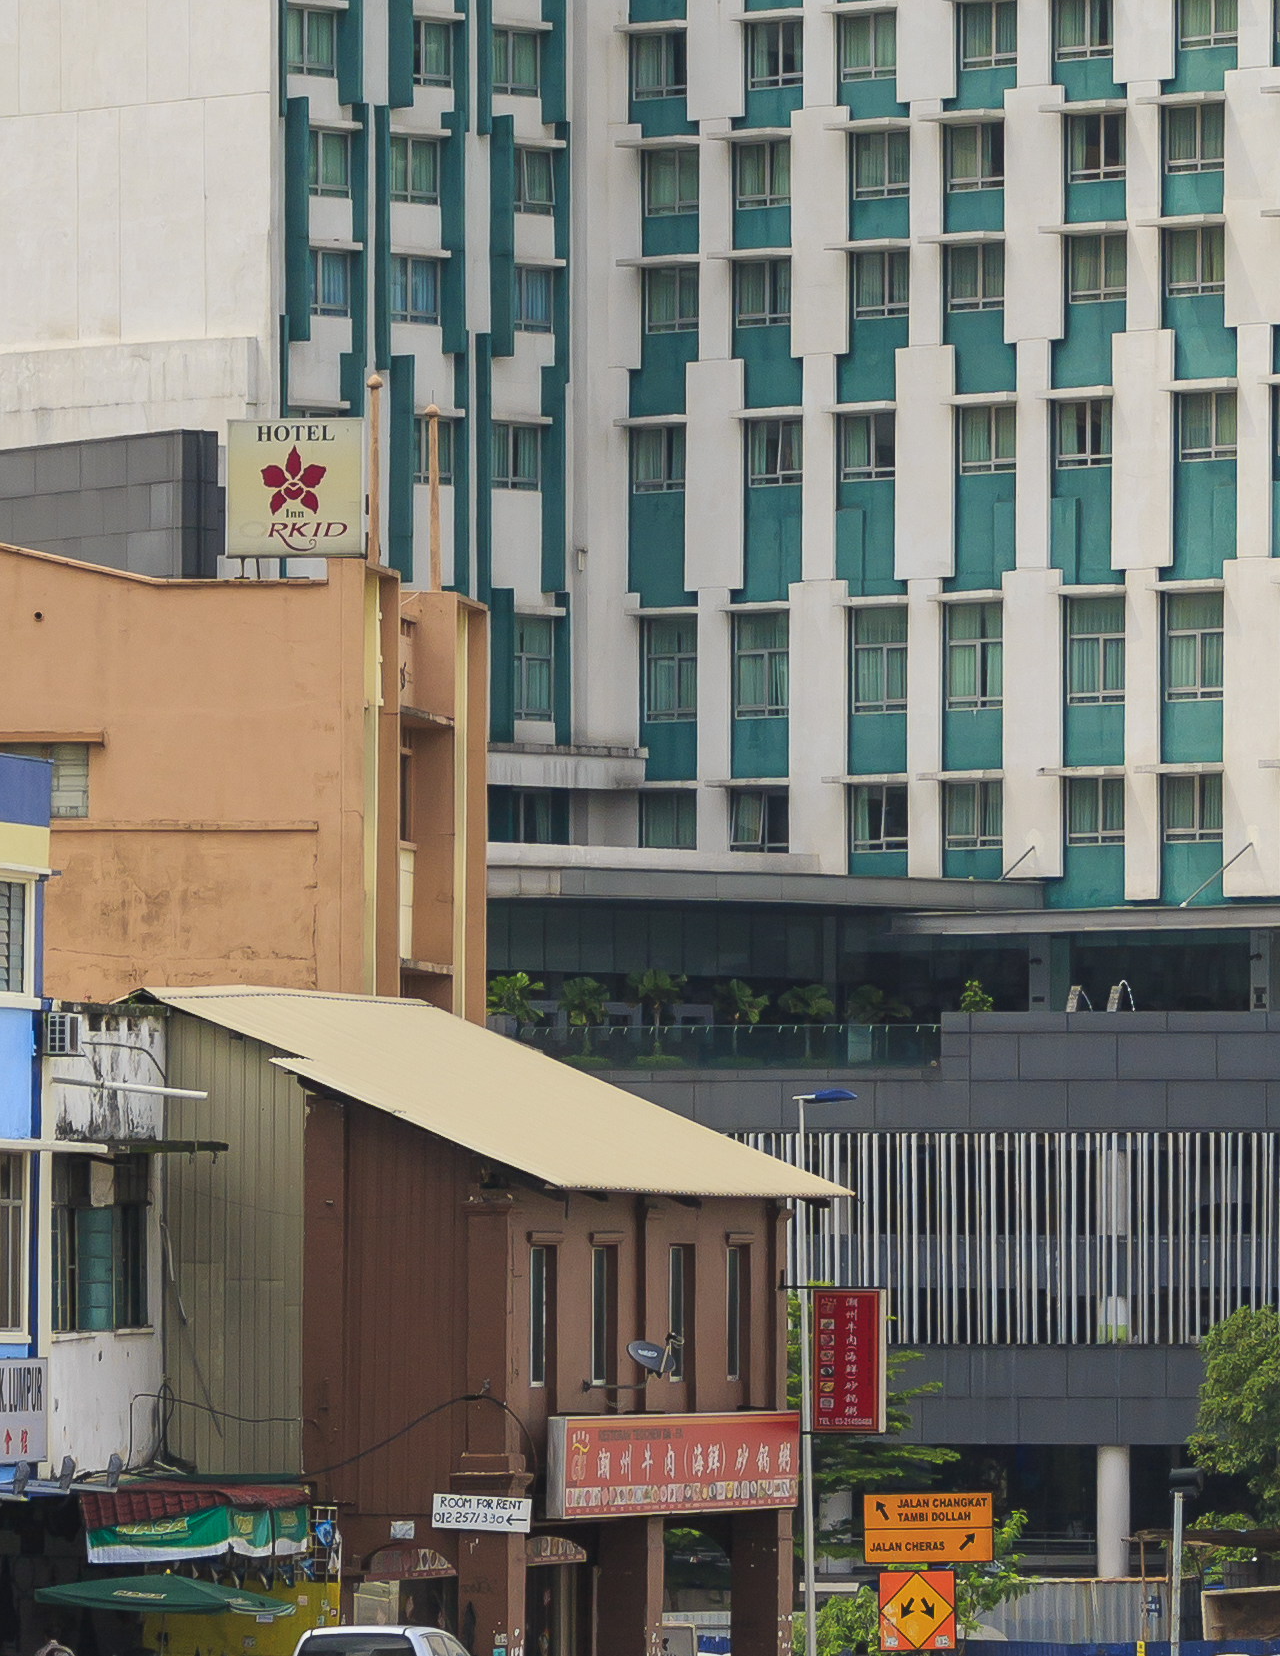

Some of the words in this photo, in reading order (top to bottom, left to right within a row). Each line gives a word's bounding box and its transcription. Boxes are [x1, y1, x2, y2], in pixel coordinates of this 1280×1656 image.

[257, 424, 335, 442] HOTEL
[285, 508, 305, 518] Inn
[8, 1367, 43, 1413] LUMPUR
[440, 1496, 472, 1509] ROOM
[476, 1498, 494, 1510] FOR
[495, 1499, 523, 1511] RENT
[897, 1498, 929, 1508] JALAN
[932, 1497, 988, 1508] CHANGKAT
[897, 1512, 928, 1522] TAMBI
[932, 1511, 971, 1522] DOLLAH
[870, 1542, 902, 1552] JALAN
[905, 1541, 946, 1552] CHERAS
